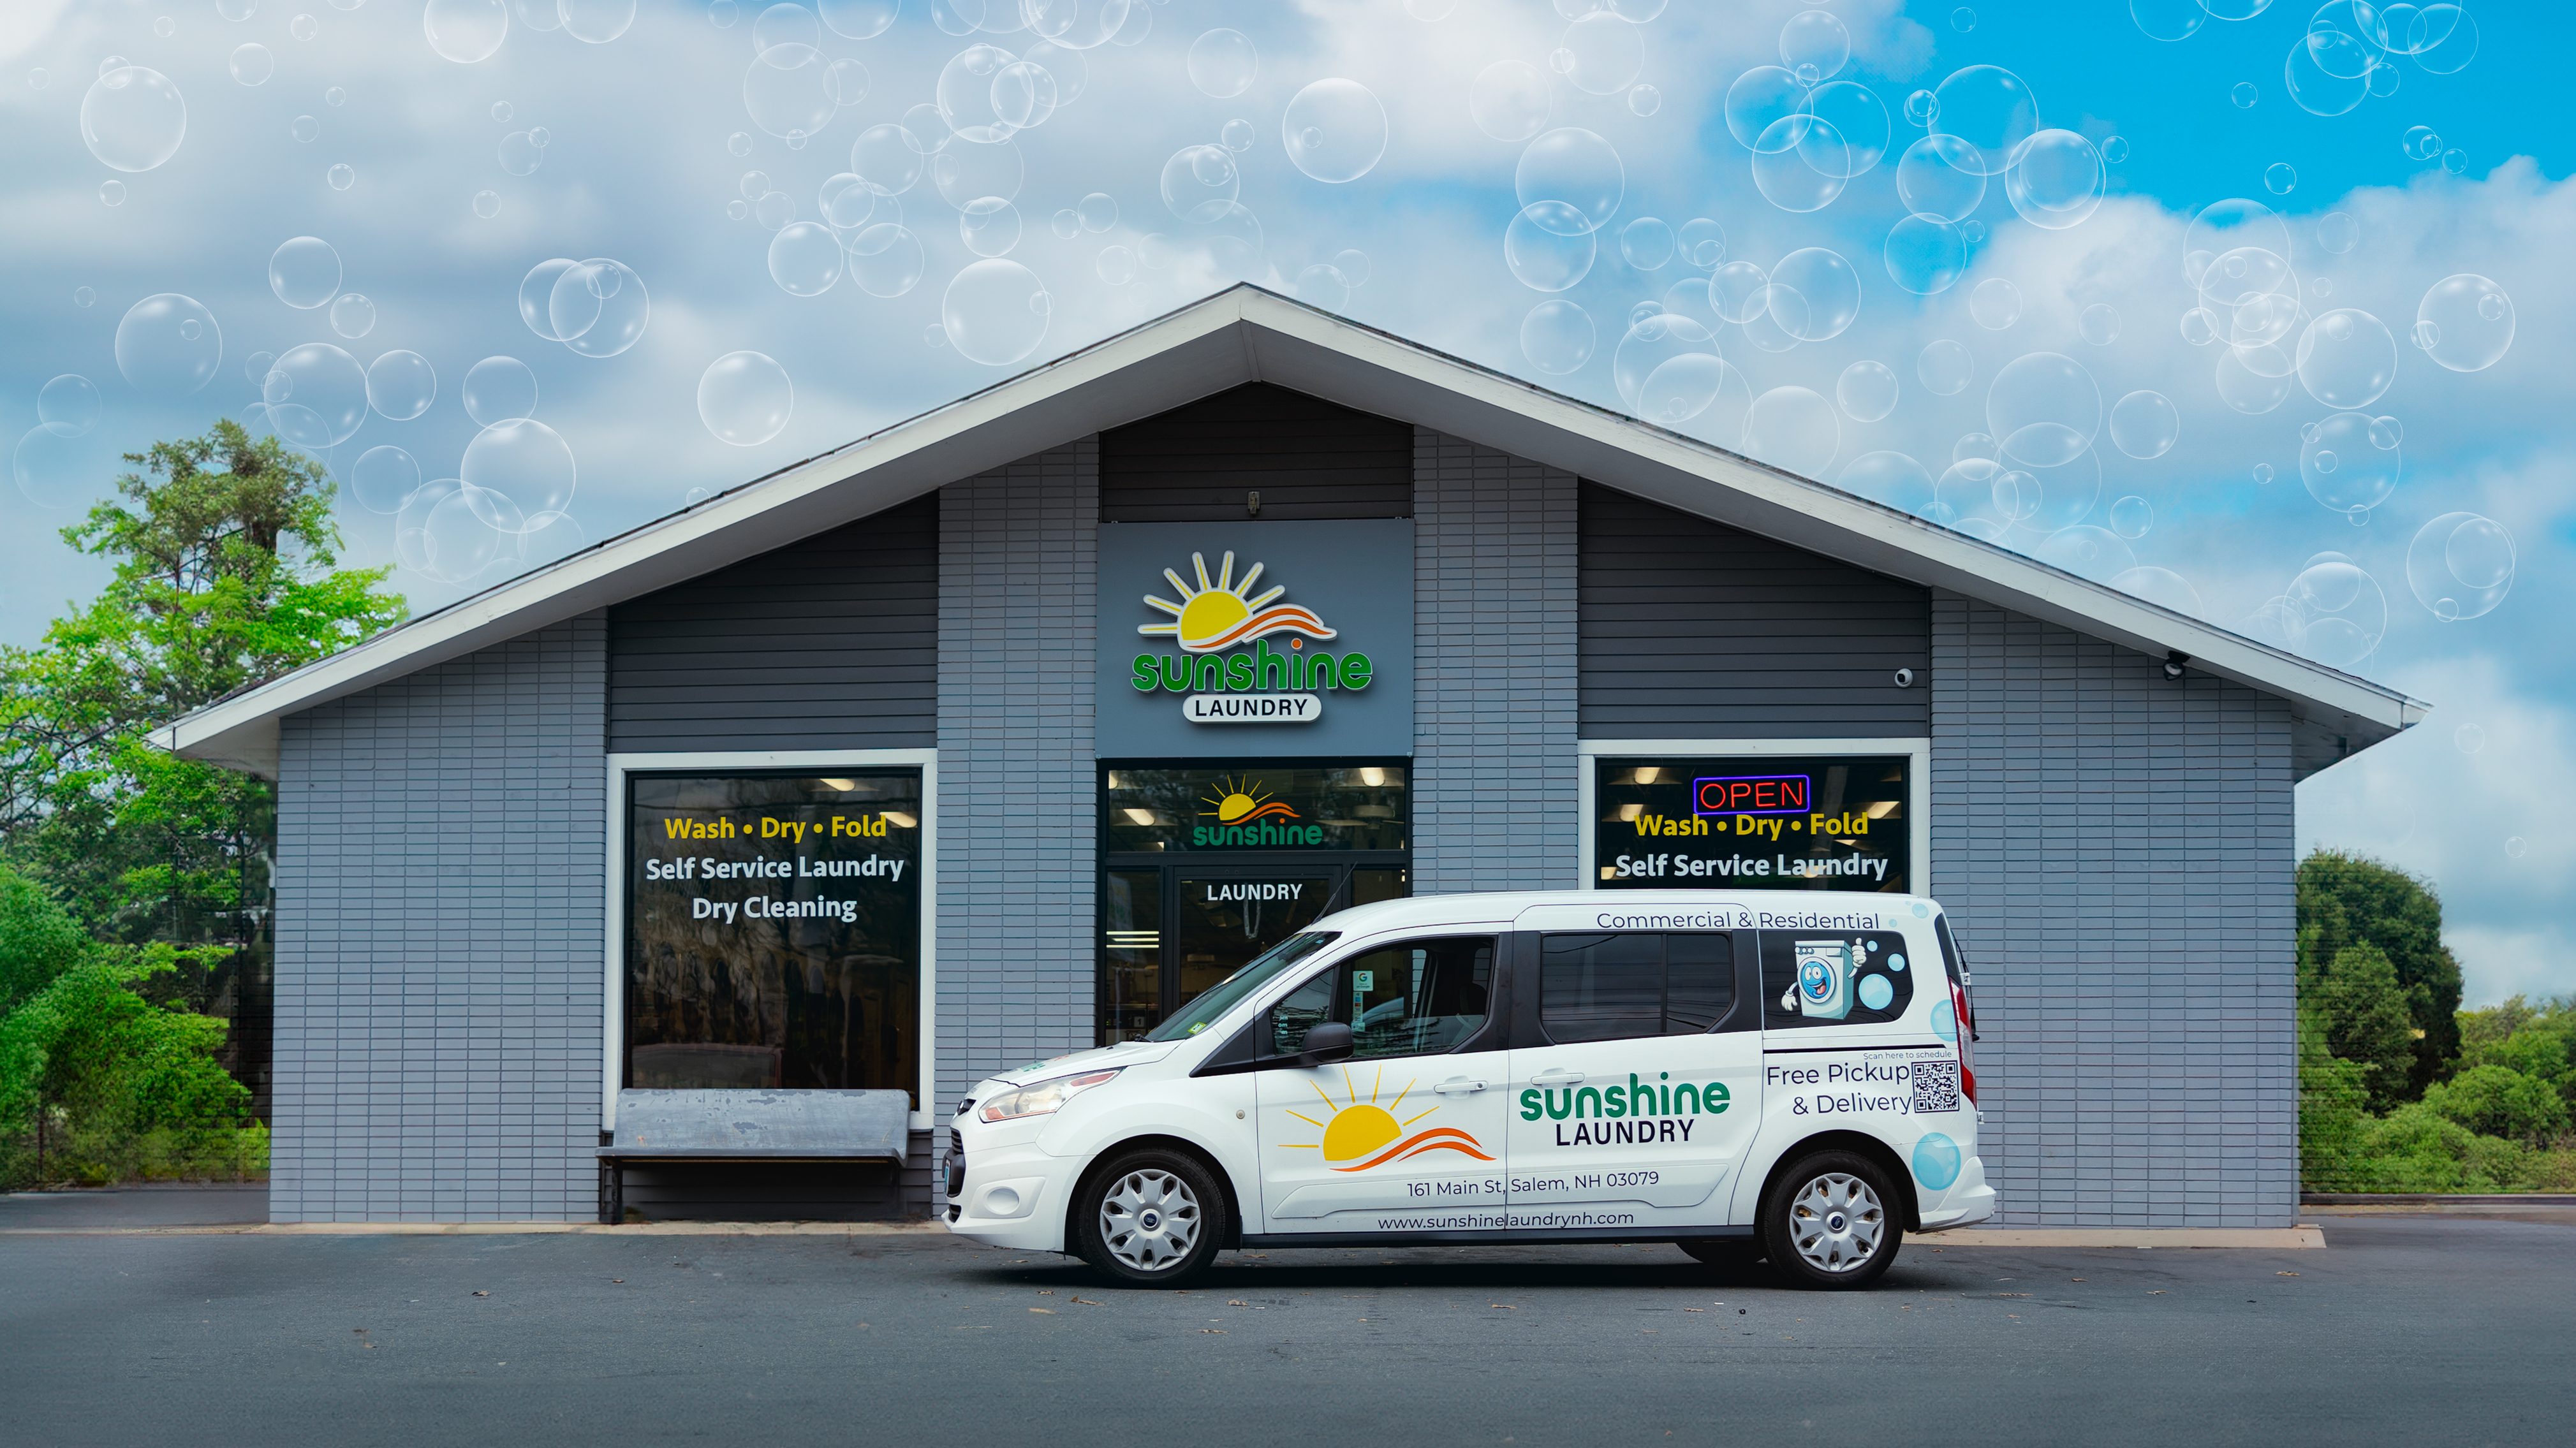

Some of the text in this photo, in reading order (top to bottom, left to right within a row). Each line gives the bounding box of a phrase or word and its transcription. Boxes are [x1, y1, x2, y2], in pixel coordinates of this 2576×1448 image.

[1131, 638, 1373, 692] sunshine
[1195, 699, 1307, 717] LAUNDRY
[1700, 781, 1803, 809] OPEN
[664, 814, 887, 844] Wash Dry Fold
[1193, 818, 1323, 846] sunshine
[1633, 812, 1869, 841] Wash Dry Fold
[646, 854, 904, 882] Self Service Laundry
[1616, 852, 1888, 881] Self Service Laundry
[1207, 884, 1303, 901] LAUNDRY
[693, 895, 857, 925] Dry Cleaning
[1597, 911, 1879, 929] Commercial & Residential
[1767, 1062, 1910, 1086] Free Pickup
[1519, 1071, 1731, 1122] sunshine
[1792, 1092, 1913, 1115] & Delivery
[1556, 1119, 1695, 1146] LAUNDRY
[1407, 1171, 1660, 1197] 161 Main St, Salem, NH 03079
[1378, 1211, 1635, 1229] www.sunshinelaundrynh.com
